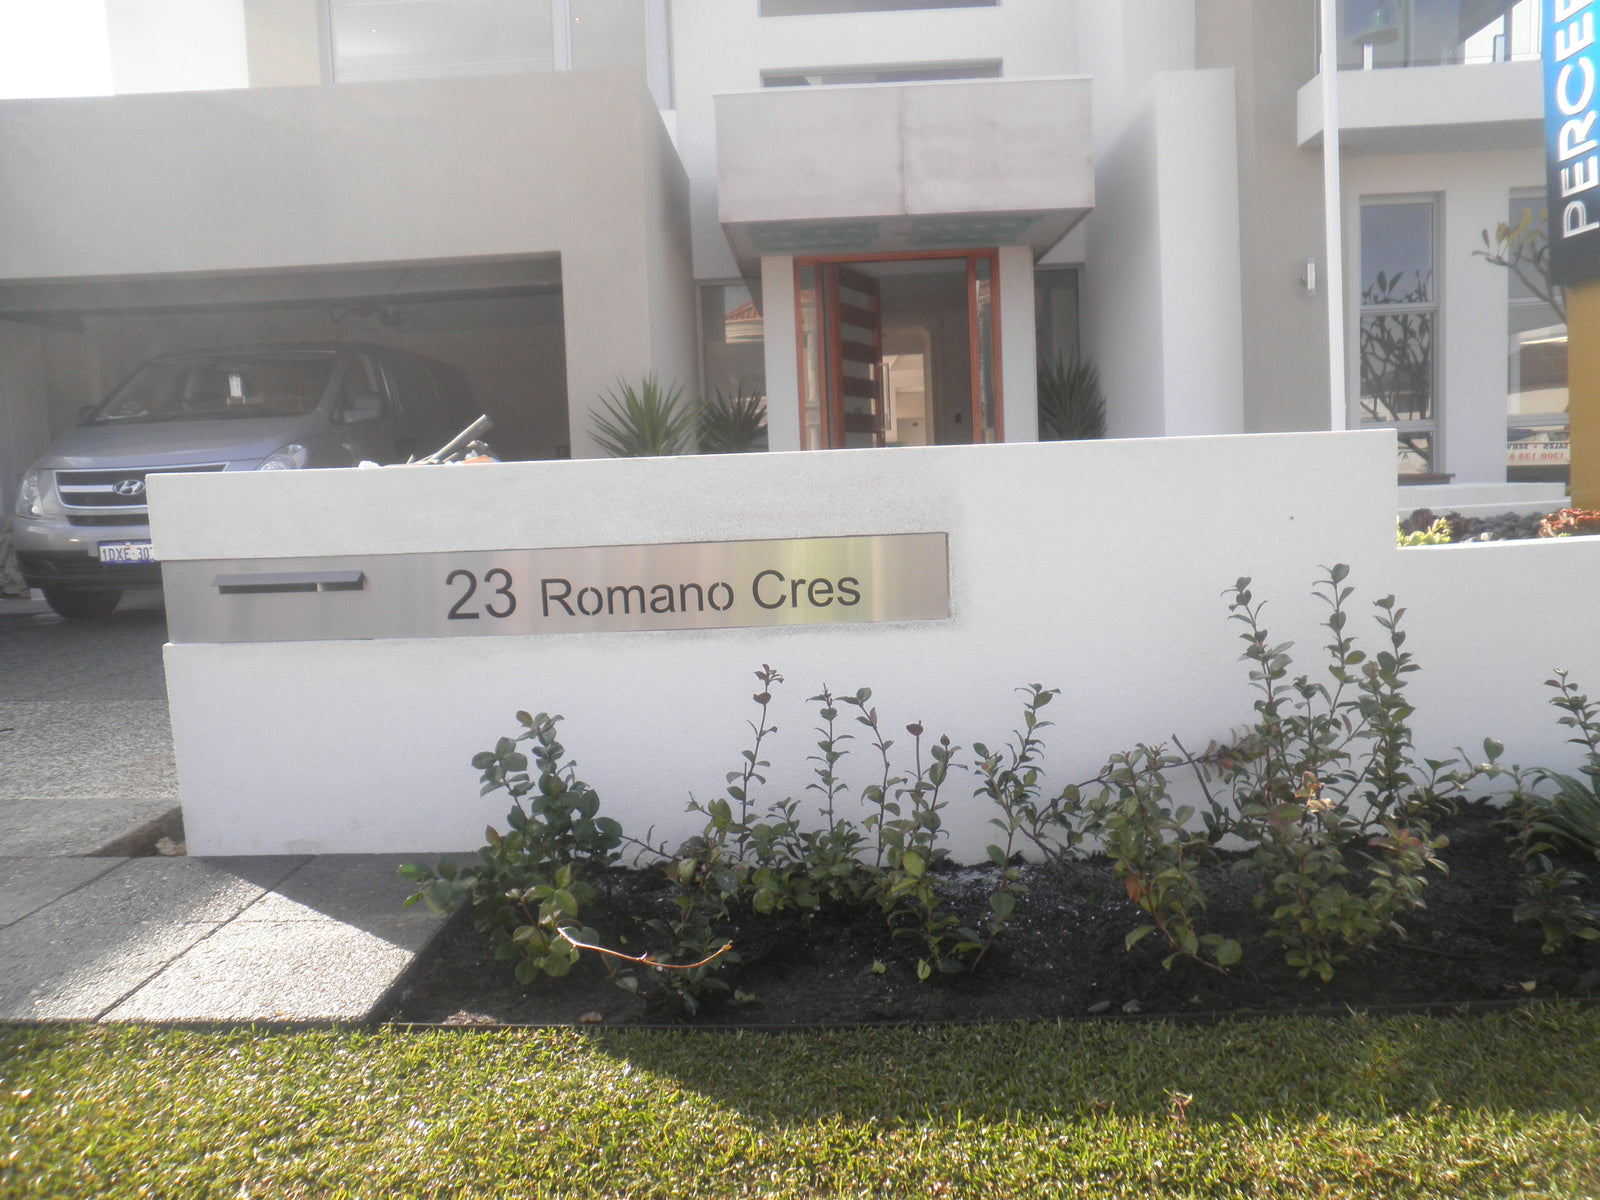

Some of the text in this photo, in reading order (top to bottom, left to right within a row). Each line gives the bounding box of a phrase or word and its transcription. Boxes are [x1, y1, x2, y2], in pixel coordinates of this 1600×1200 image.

[445, 567, 861, 620] 23 Romano Cres
